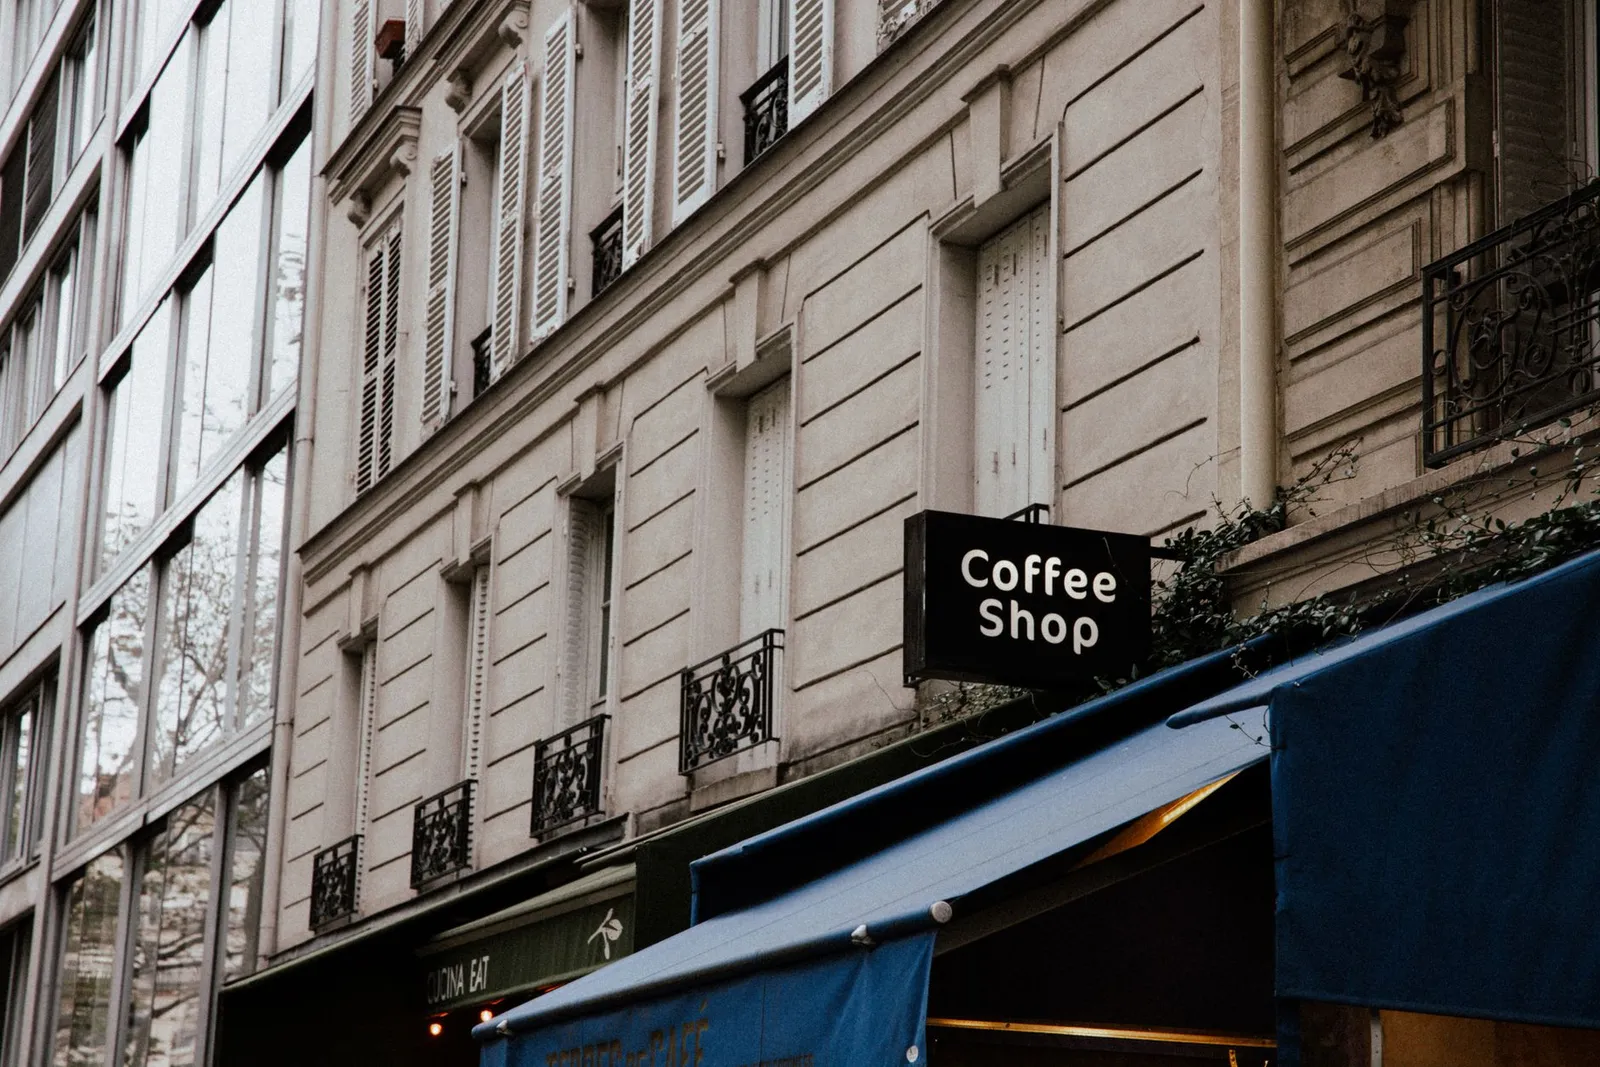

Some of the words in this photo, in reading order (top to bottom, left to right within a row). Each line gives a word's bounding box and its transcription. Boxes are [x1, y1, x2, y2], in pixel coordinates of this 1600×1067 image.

[961, 549, 1117, 603] Coffee
[979, 598, 1099, 655] Shop
[427, 964, 464, 1005] CUCINA
[469, 955, 490, 993] EAT
